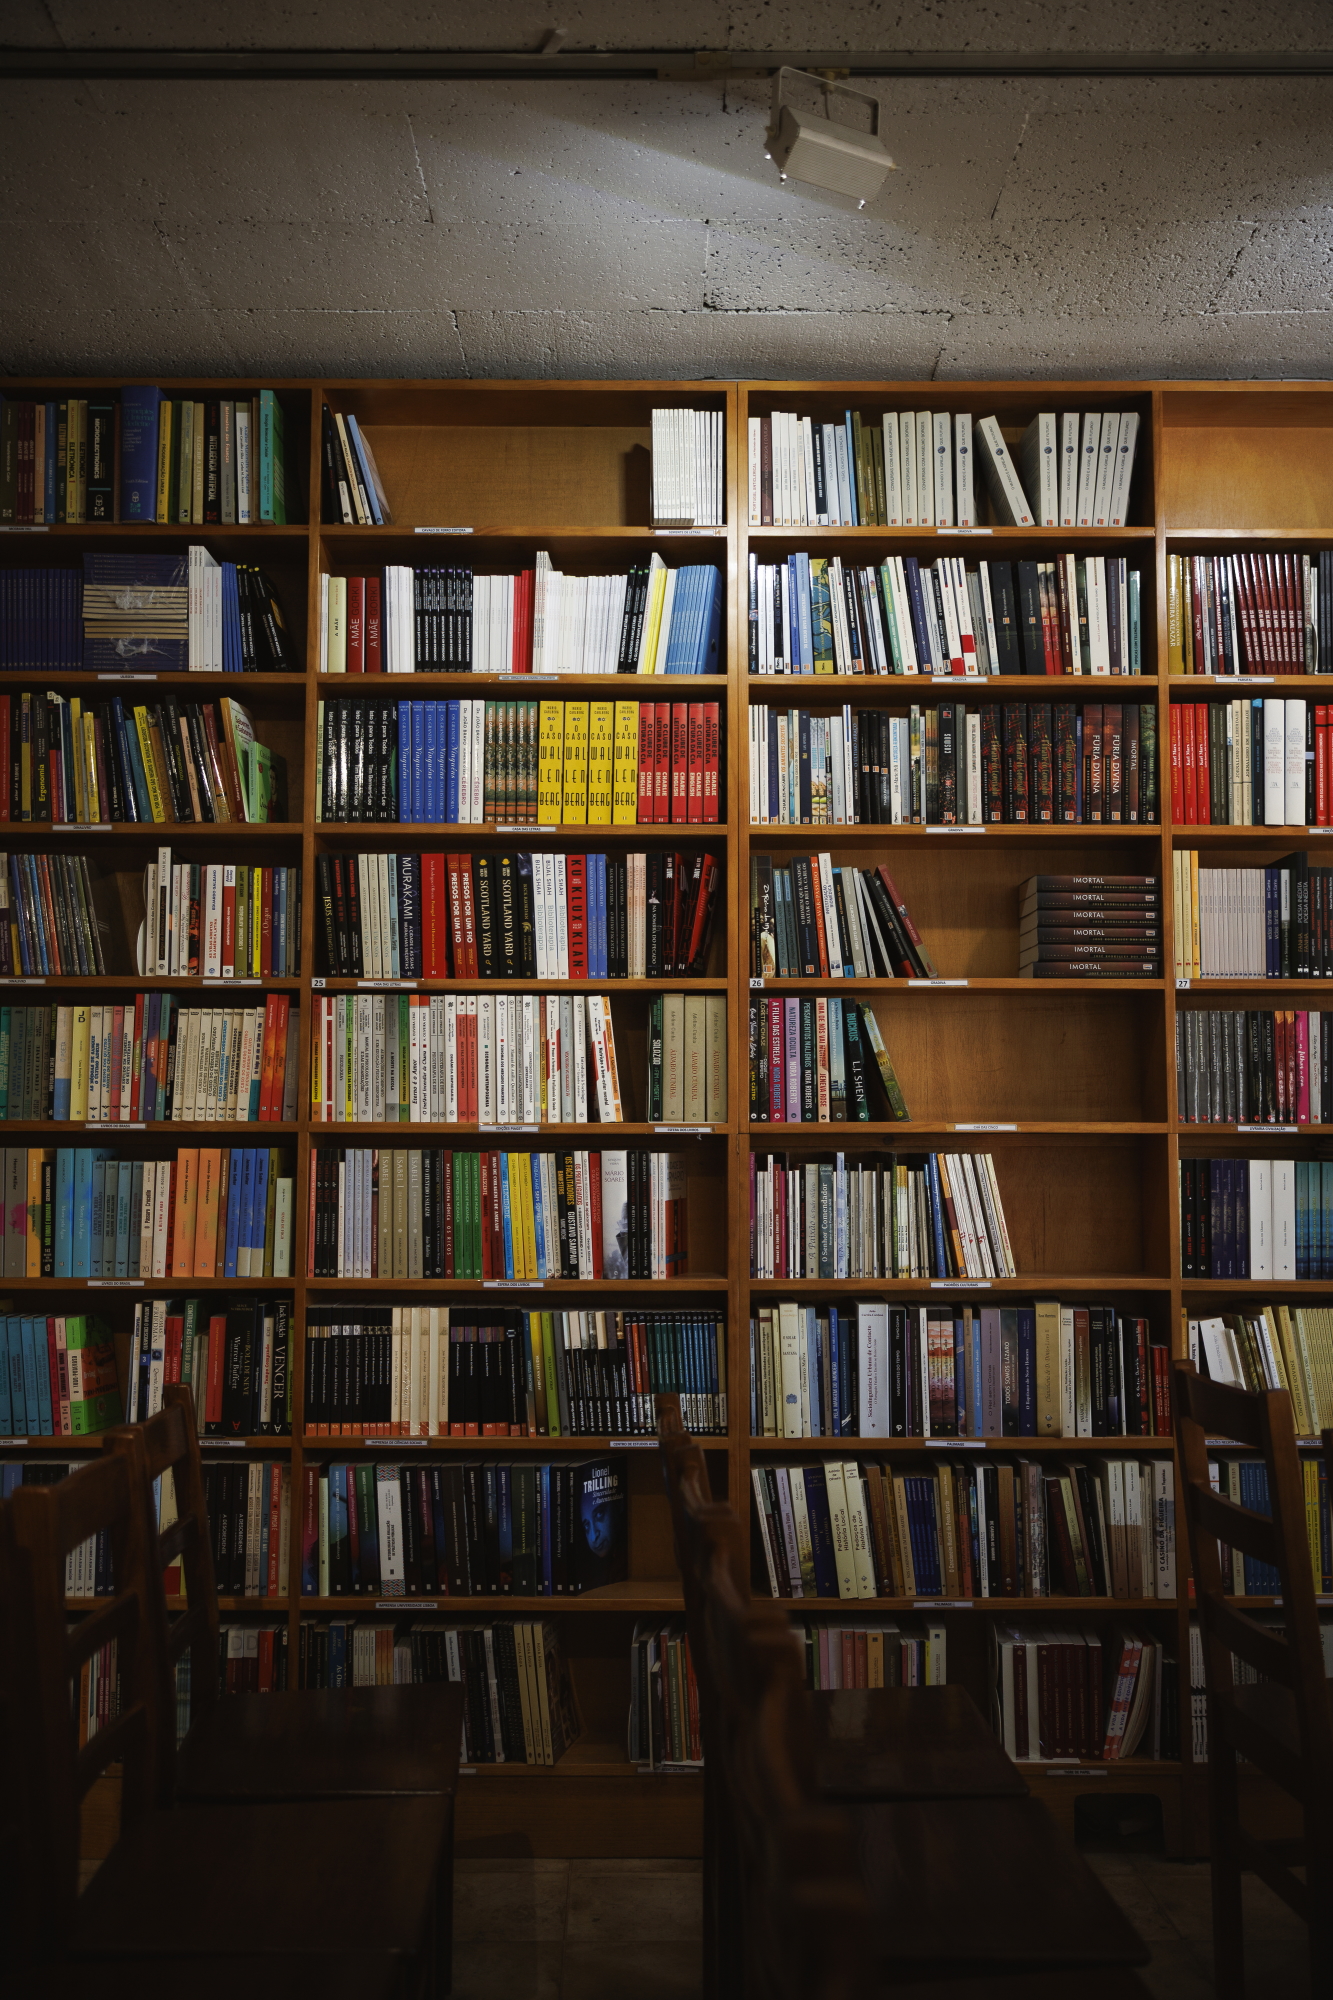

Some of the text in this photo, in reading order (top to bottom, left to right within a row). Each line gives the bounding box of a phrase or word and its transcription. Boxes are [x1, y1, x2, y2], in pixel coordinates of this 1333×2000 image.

[208, 435, 218, 501] INTELIGÊNCIA ARTIFICIAL
[351, 586, 360, 616] GORKI
[368, 586, 378, 648] A MÃE GORKI
[1169, 587, 1177, 619] OLIVEIRA
[350, 618, 360, 639] MÃE
[540, 732, 562, 740] CASO
[640, 743, 647, 753] DA
[647, 749, 653, 758] DE
[1092, 734, 1101, 794] FÚRIA DIVINA
[1112, 734, 1121, 794] FÚRIA DIVINA
[38, 764, 47, 802] Ergonomia
[461, 776, 469, 806] CÉREBRO
[570, 859, 582, 876] KU
[402, 857, 413, 920] MURAKAMI
[462, 872, 471, 899] PRESOS
[464, 900, 472, 916] POR
[480, 880, 492, 956] SCOTLAND YARD
[502, 879, 514, 956] SCOTLAND YARD
[571, 886, 583, 921] KLUX
[465, 917, 472, 930] UM
[536, 904, 545, 951] Biblioterapia
[572, 931, 584, 967] KLAN
[1178, 980, 1188, 988] 27
[772, 1007, 781, 1024] FILHA
[772, 1024, 781, 1036] DAS
[817, 1002, 826, 1044] UMA DE NÓS VAI
[846, 1013, 859, 1042] RUCKUS
[788, 1006, 797, 1058] NATUREZA OCULTA
[803, 1002, 812, 1068] PENSAMENTOS MALIGNOS
[772, 1037, 781, 1065] ESTRELAS
[772, 1067, 781, 1110] NORA ROBERTS
[819, 1073, 827, 1107] JENEVA ROSE
[852, 1060, 865, 1102] L.J. SHEN
[564, 1156, 575, 1205] OS FACILITADORES
[446, 1225, 452, 1234] OS
[567, 1211, 578, 1265] GUSTAVO SAMPAIO
[186, 1305, 194, 1328] CONTROLE
[278, 1305, 286, 1338] Jack Welch
[183, 1362, 191, 1374] JOGO
[184, 1354, 192, 1362] DO
[243, 1345, 251, 1396] BOLA DE NEVE
[273, 1346, 286, 1399] VENCER
[1003, 1341, 1012, 1404] TODOS SOMOS LÁZARO
[583, 1474, 619, 1494] TRILLING
[591, 1465, 610, 1479] Lionel
[1158, 1497, 1166, 1528] FIGUEIRA
[833, 1513, 844, 1552] Pedaços de
[839, 1508, 849, 1551] História Local
[1158, 1529, 1166, 1539] DA
[1158, 1540, 1166, 1565] CASINO
